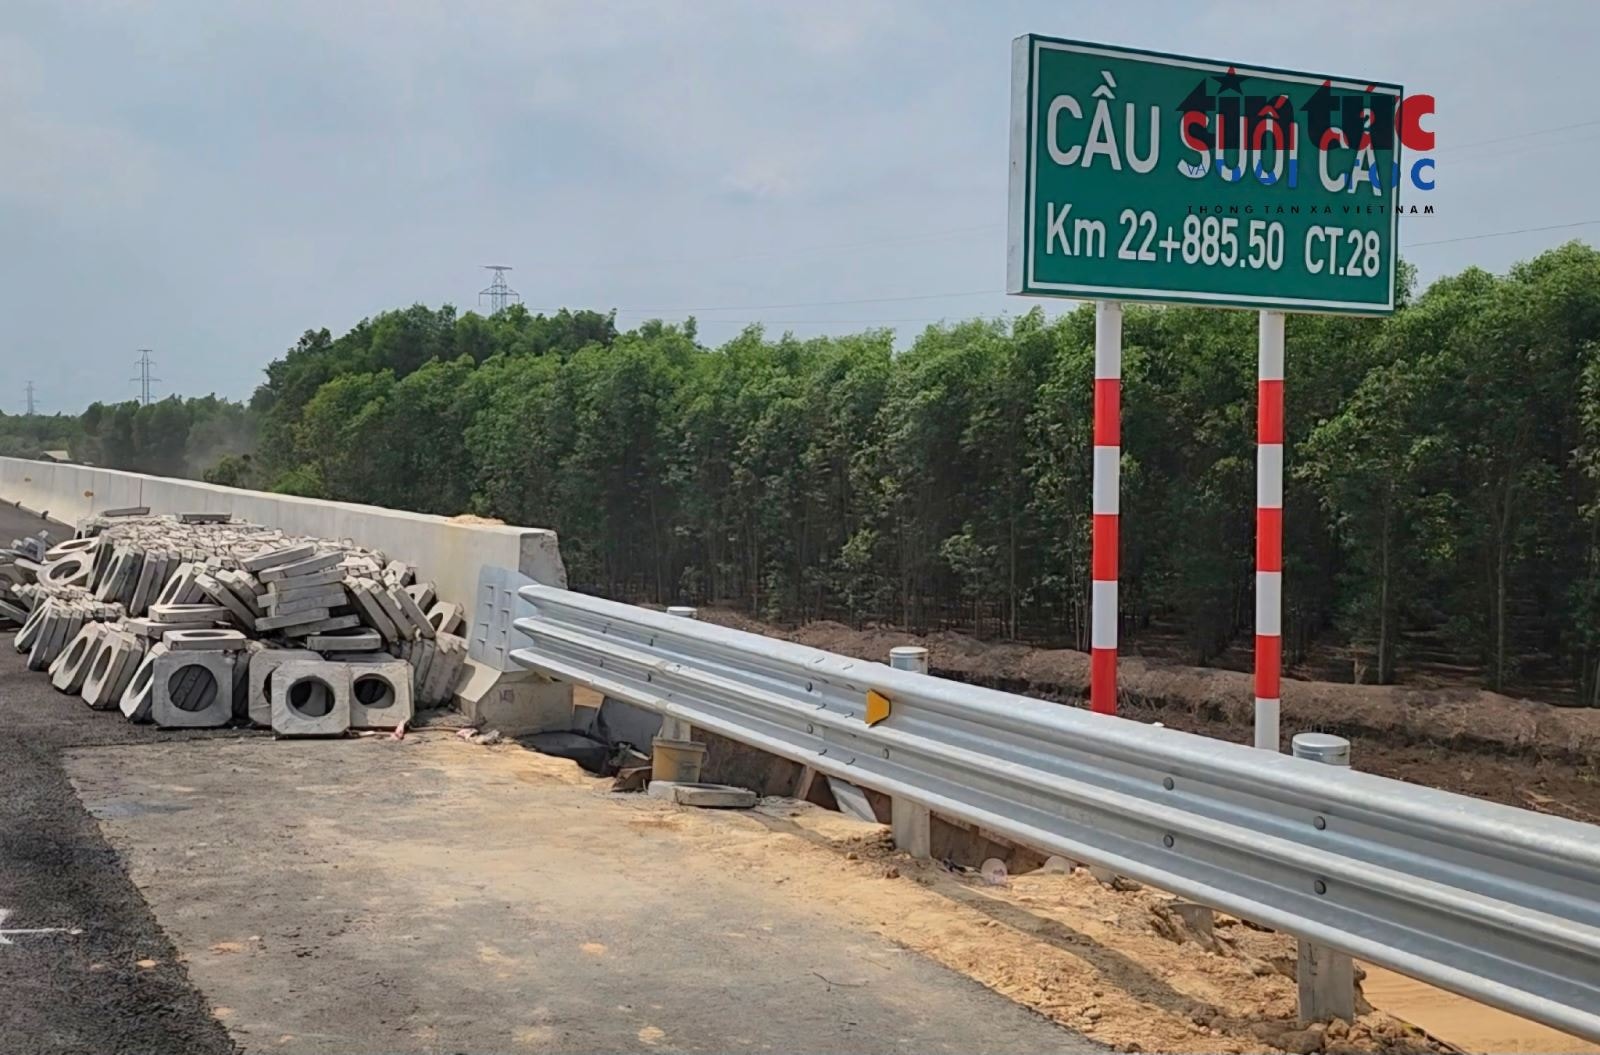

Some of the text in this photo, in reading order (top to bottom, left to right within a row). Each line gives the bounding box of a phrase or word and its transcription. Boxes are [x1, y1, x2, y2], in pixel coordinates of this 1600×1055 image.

[1047, 70, 1382, 196] CẦU SUỐI CẢ
[1046, 202, 1381, 279] Km 22+885.50 CT.28
